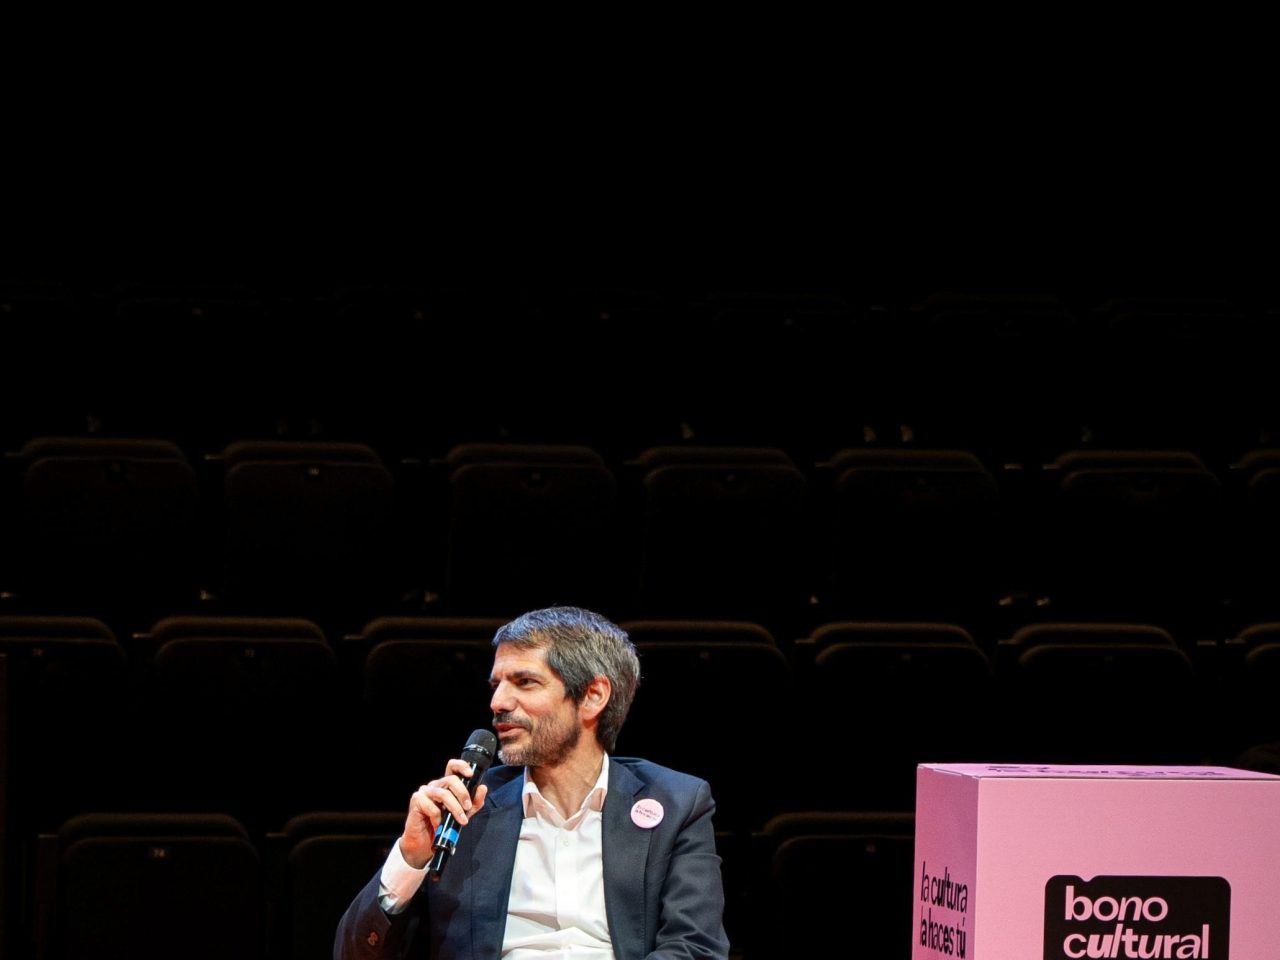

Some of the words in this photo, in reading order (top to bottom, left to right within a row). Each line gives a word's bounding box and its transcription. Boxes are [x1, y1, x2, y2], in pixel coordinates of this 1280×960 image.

[920, 861, 930, 903] la
[931, 866, 968, 914] cultura
[1063, 885, 1169, 922] bono
[928, 908, 954, 956] haces
[956, 916, 966, 960] tú
[1062, 923, 1210, 960] cultural
